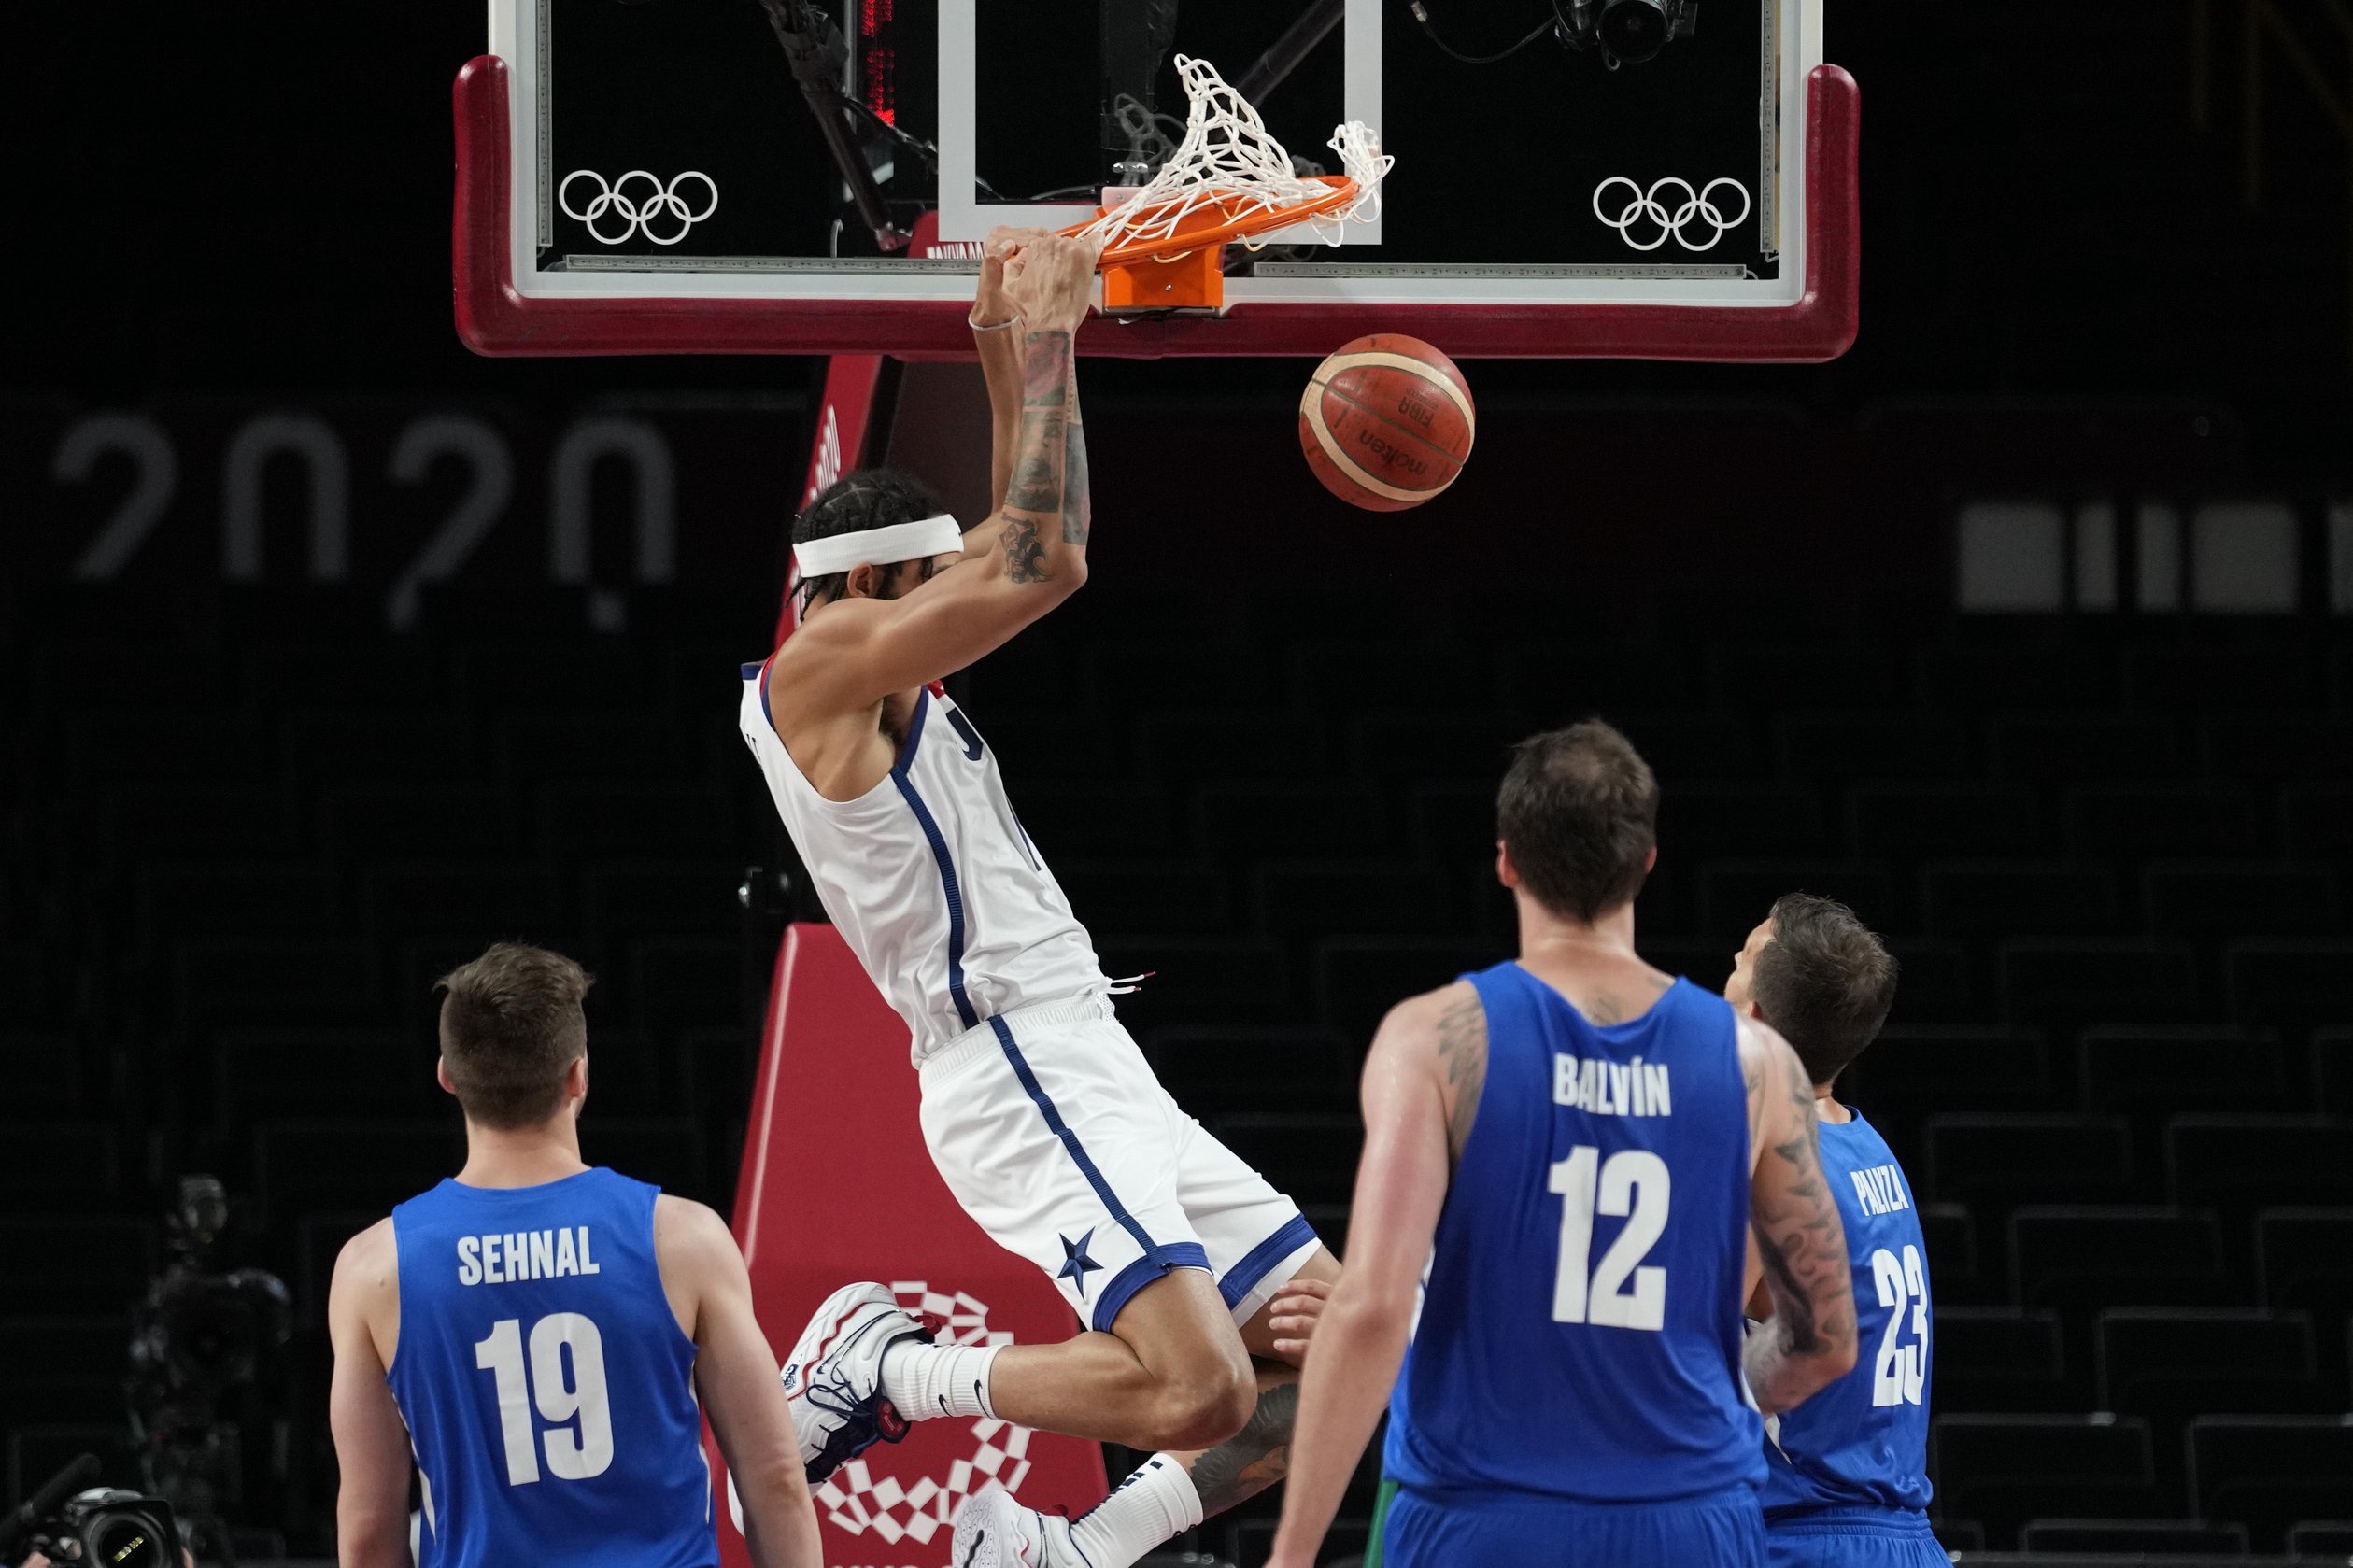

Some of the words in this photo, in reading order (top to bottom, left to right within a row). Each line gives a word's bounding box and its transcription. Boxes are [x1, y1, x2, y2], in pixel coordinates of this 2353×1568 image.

[1358, 429, 1428, 477] molten
[1397, 396, 1436, 430] FIBA
[50, 409, 679, 632] 2020
[1552, 1052, 1672, 1118] BALVÍN
[456, 1225, 601, 1287] SEHNAL
[1546, 1144, 1671, 1332] 12
[1871, 1243, 1929, 1408] 23
[474, 1311, 616, 1487] 19
